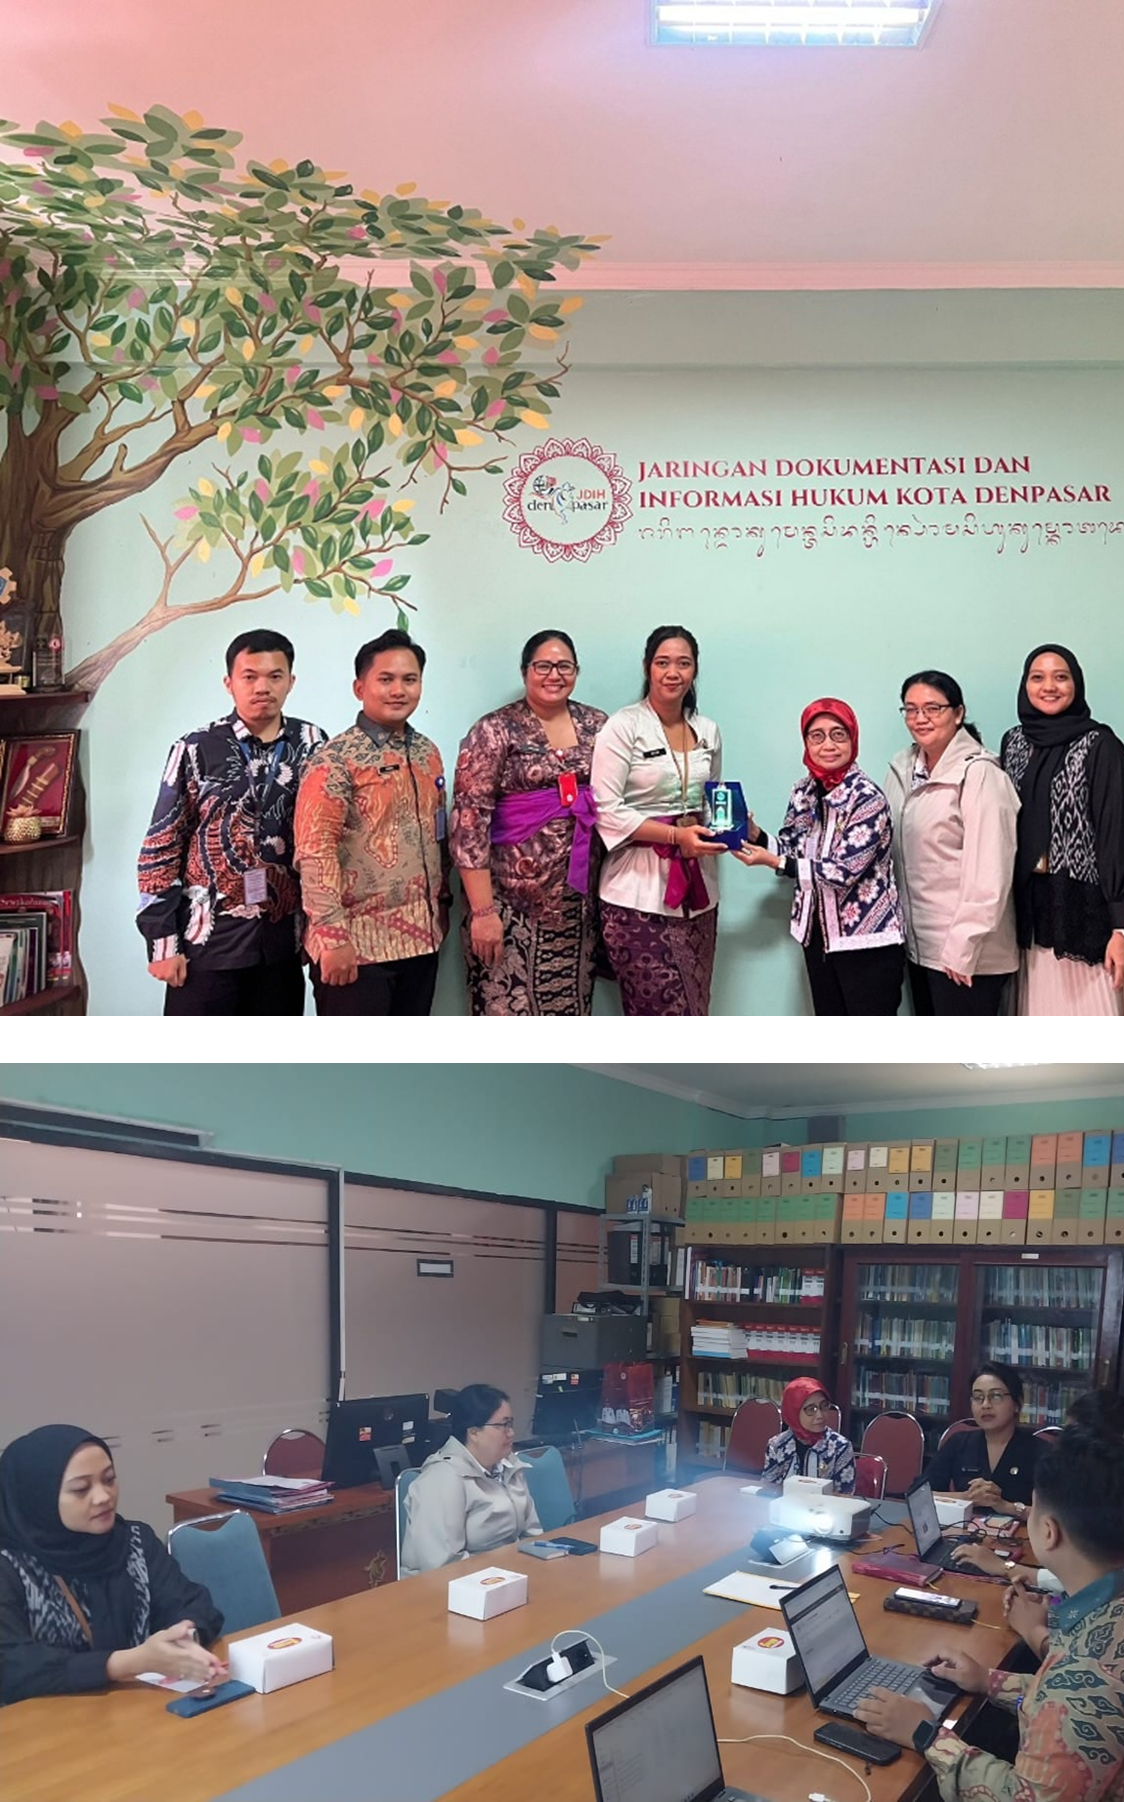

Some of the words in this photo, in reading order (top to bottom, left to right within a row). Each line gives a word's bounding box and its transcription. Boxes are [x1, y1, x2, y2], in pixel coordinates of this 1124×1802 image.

[639, 459, 767, 482] JARINGAN
[776, 456, 966, 477] DOKUMENTASI
[975, 456, 1030, 474] DAN
[576, 489, 606, 500] JDIH
[640, 489, 782, 508] INFORMASI
[791, 487, 889, 507] HUKUM
[896, 486, 968, 505] KOTA
[975, 484, 1111, 504] DENPASAR
[527, 500, 555, 511] den
[571, 500, 609, 513] pasar
